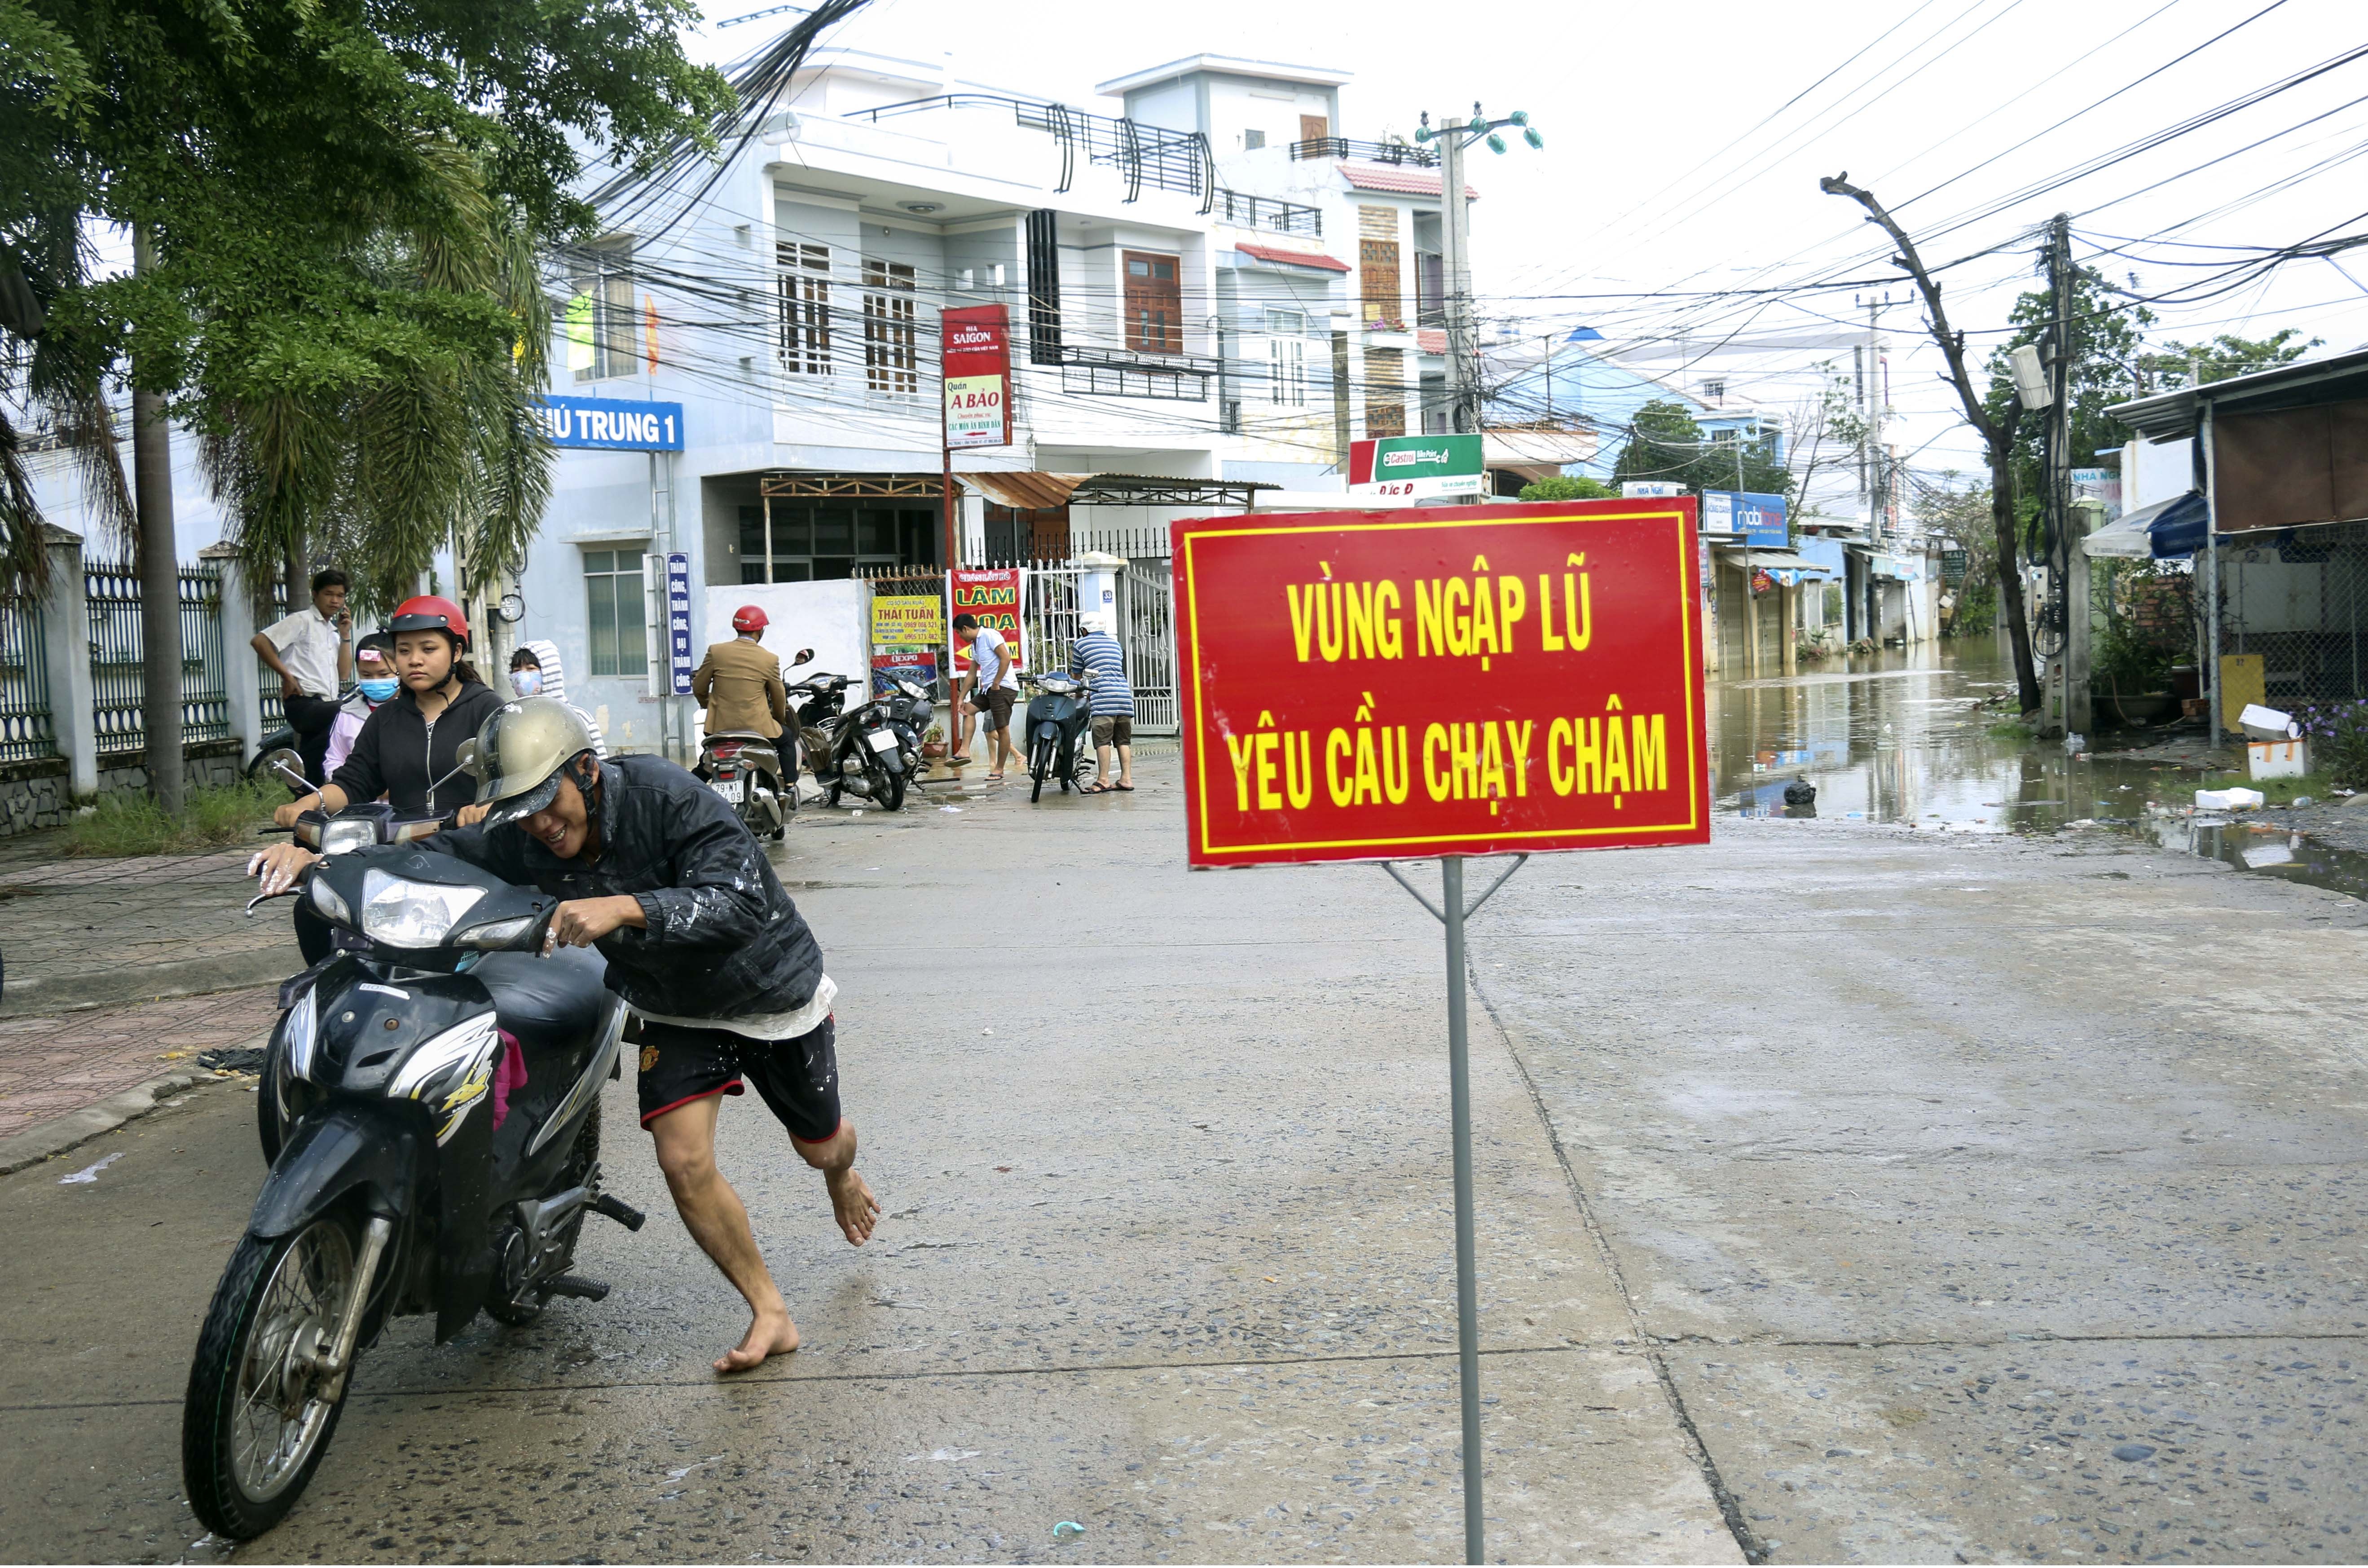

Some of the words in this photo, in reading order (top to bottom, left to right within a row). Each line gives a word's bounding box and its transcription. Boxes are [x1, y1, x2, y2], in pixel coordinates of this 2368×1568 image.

[953, 332, 990, 344] SAIGON
[948, 381, 967, 392] Quán
[951, 395, 962, 410] A
[966, 388, 999, 408] BẢO
[575, 410, 659, 443] TRUNG
[665, 415, 675, 443] 1
[949, 422, 958, 431] CÁC
[959, 421, 969, 430] MÓN
[991, 419, 1001, 428] DÂN
[1391, 452, 1414, 464] Castrol
[1426, 449, 1437, 458] Point
[1737, 506, 1782, 526] mobifone
[670, 560, 687, 573] THÀNH
[671, 579, 687, 594] CÔNG,
[955, 586, 1016, 606] LÂM
[672, 598, 688, 611] THÀNH
[1287, 561, 1403, 662] VÙNG
[1415, 555, 1525, 671] NGẬP
[1539, 552, 1591, 651] LŨ
[878, 607, 902, 620] THÁI
[905, 606, 934, 619] TUẤN
[673, 617, 688, 631] CÔNG,
[973, 613, 1017, 630] OA
[677, 638, 687, 652] ĐẠI
[674, 654, 691, 668] THÀNH
[676, 673, 690, 687] CÔNG
[1228, 711, 1312, 811] YÊU
[1326, 692, 1408, 807] CẦU
[1423, 720, 1532, 815] CHẠY
[1548, 694, 1667, 809] CHẬM
